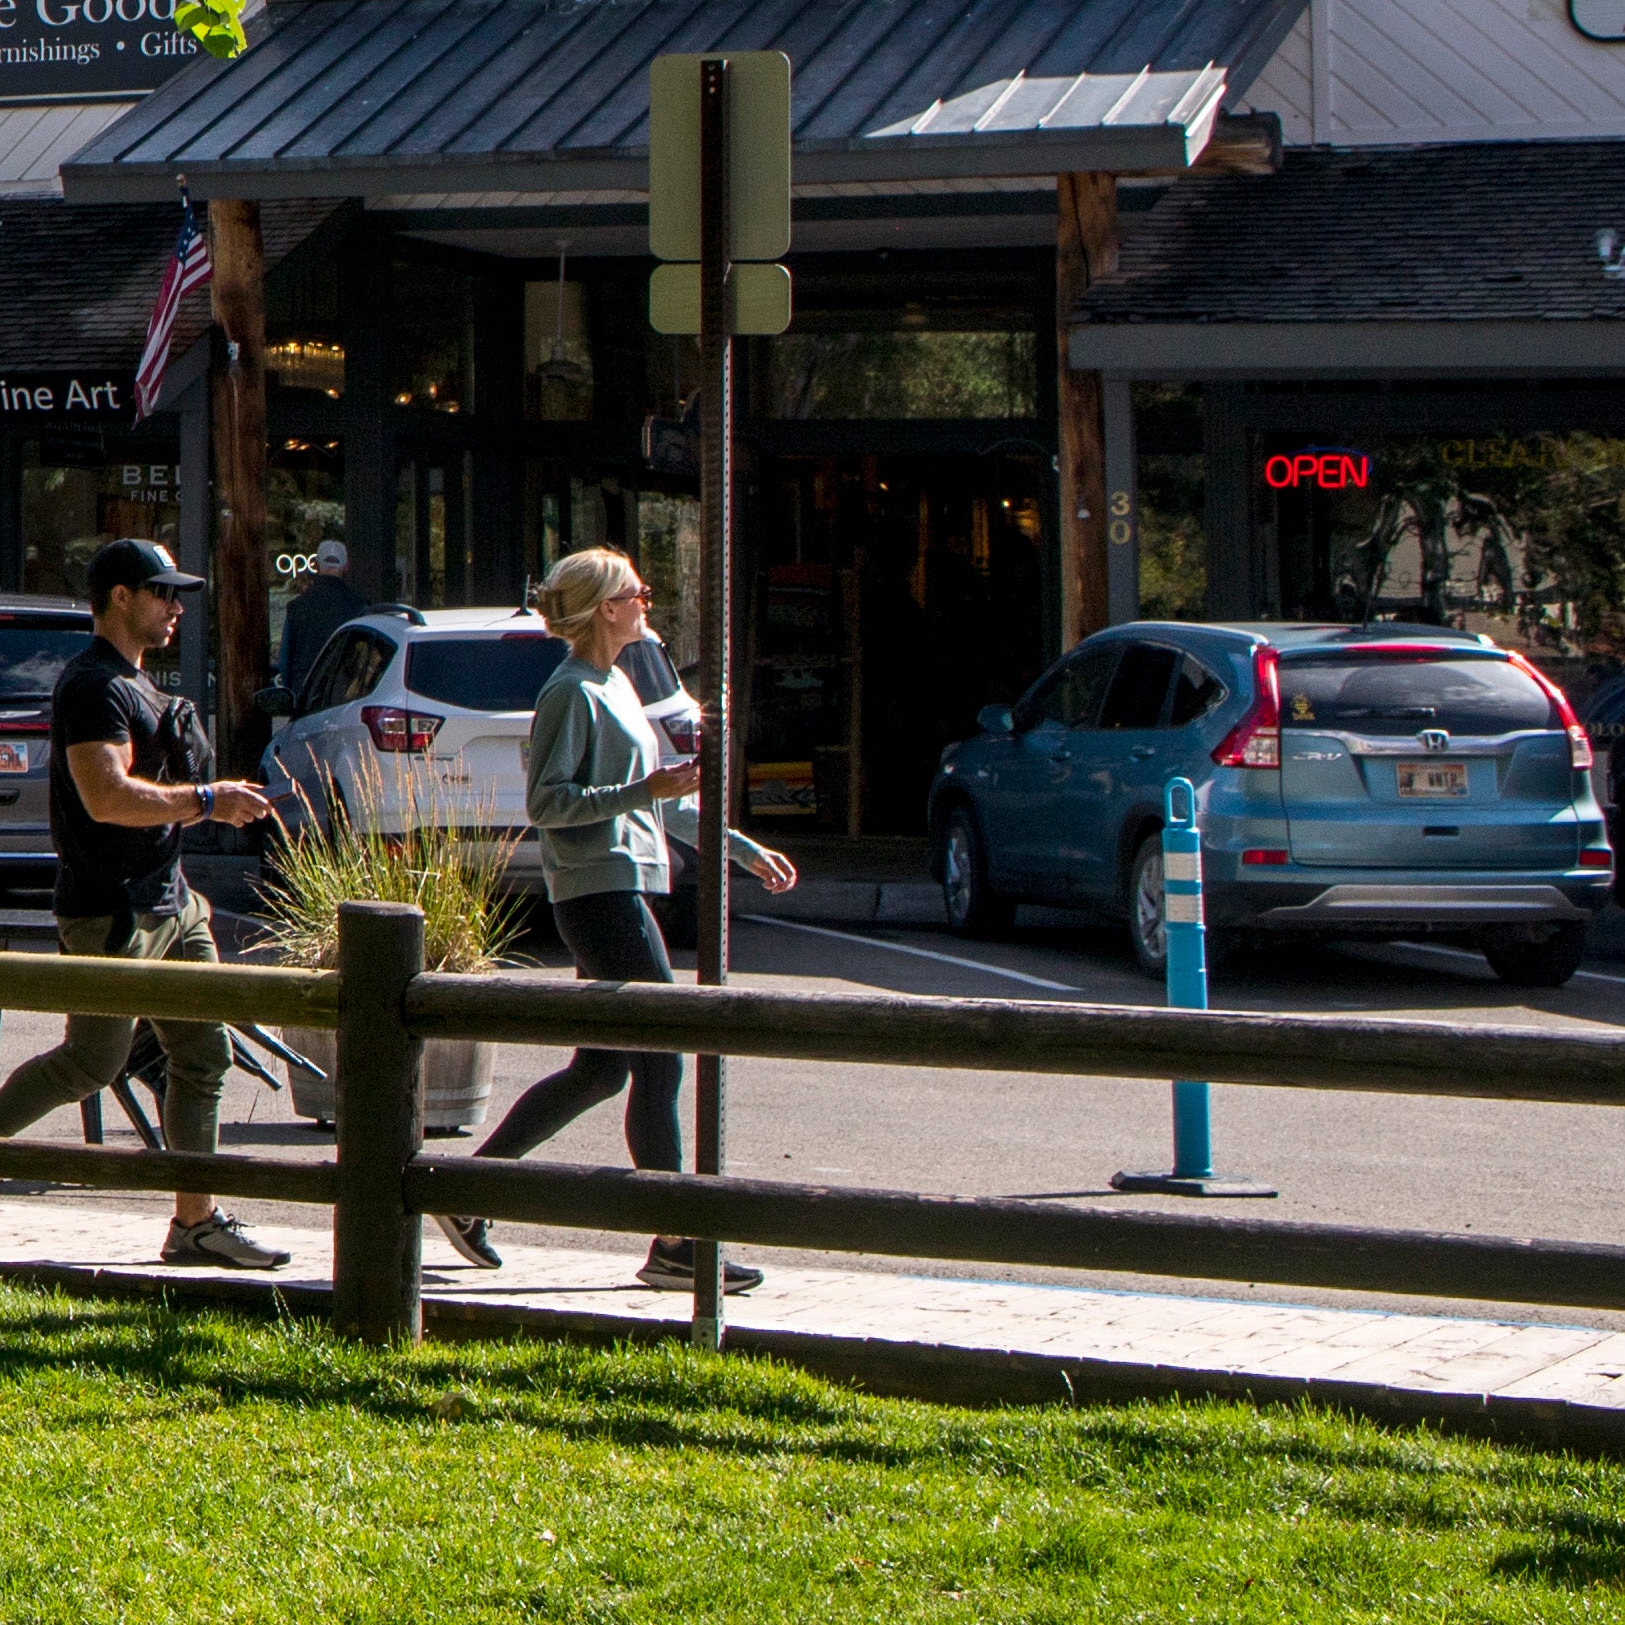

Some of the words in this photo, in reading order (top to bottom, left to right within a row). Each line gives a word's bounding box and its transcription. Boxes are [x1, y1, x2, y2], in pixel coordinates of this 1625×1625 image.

[140, 31, 198, 57] Gifts
[65, 378, 120, 410] Art
[1265, 454, 1369, 489] OPEN
[130, 490, 169, 502] FINE
[276, 553, 319, 579] ope
